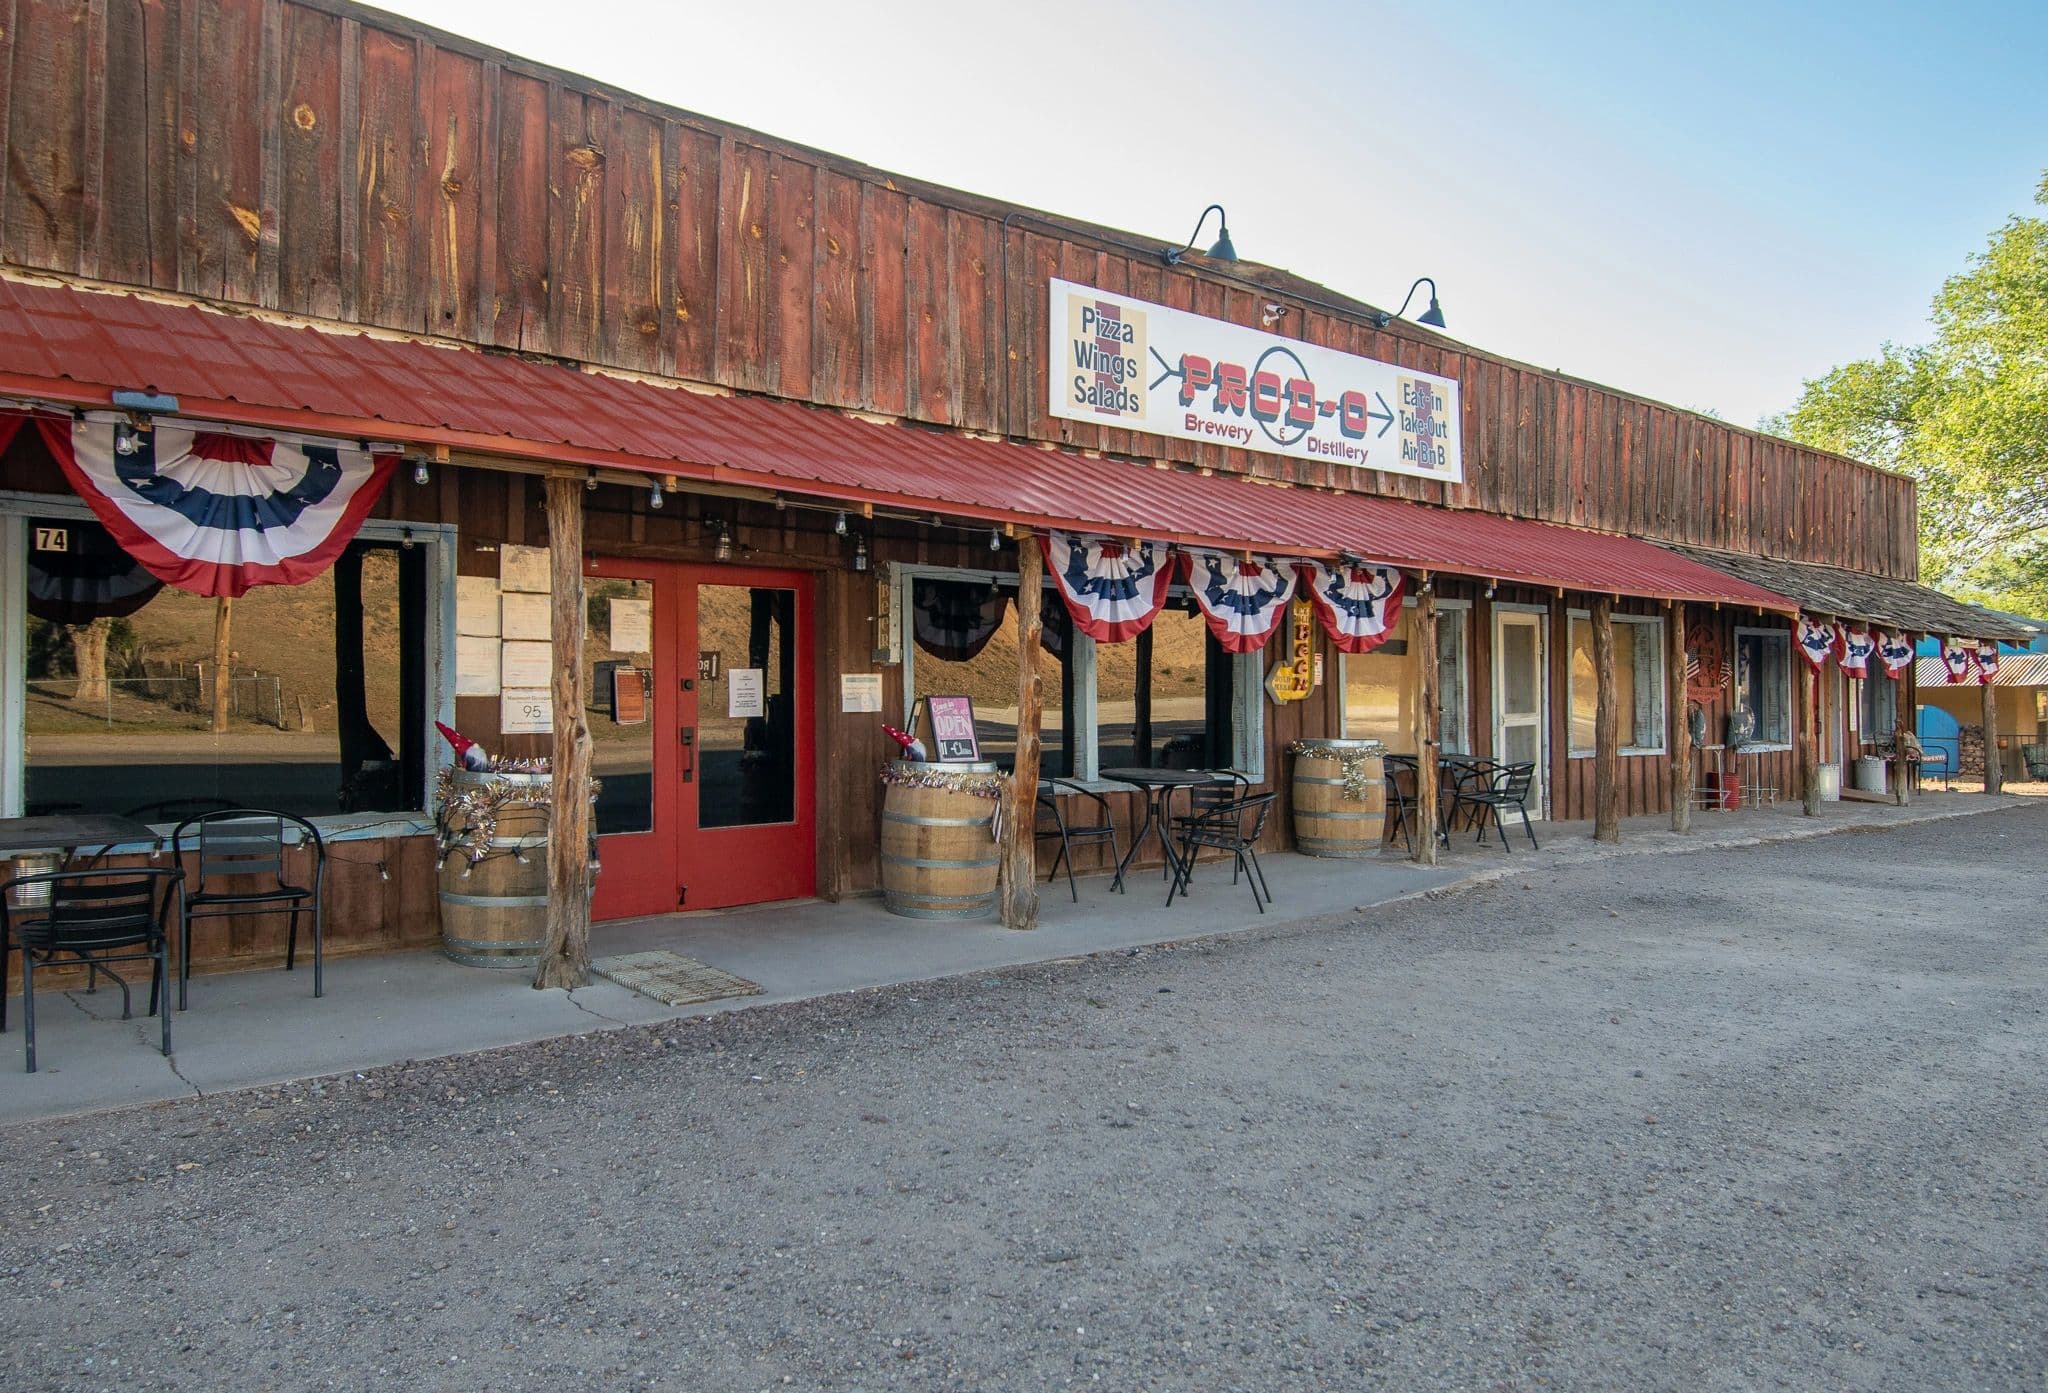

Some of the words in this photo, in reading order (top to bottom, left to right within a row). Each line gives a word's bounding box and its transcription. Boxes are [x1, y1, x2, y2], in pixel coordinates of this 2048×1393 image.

[1082, 306, 1134, 344] Pizza
[1073, 339, 1138, 384] Wings
[1074, 375, 1140, 413] Salads
[1178, 353, 1368, 440] PROD-O
[1185, 413, 1254, 445] Brewery
[1399, 409, 1448, 439] Take-Out
[39, 530, 65, 549] 74
[523, 705, 542, 718] 95
[935, 714, 974, 736] OPEN
